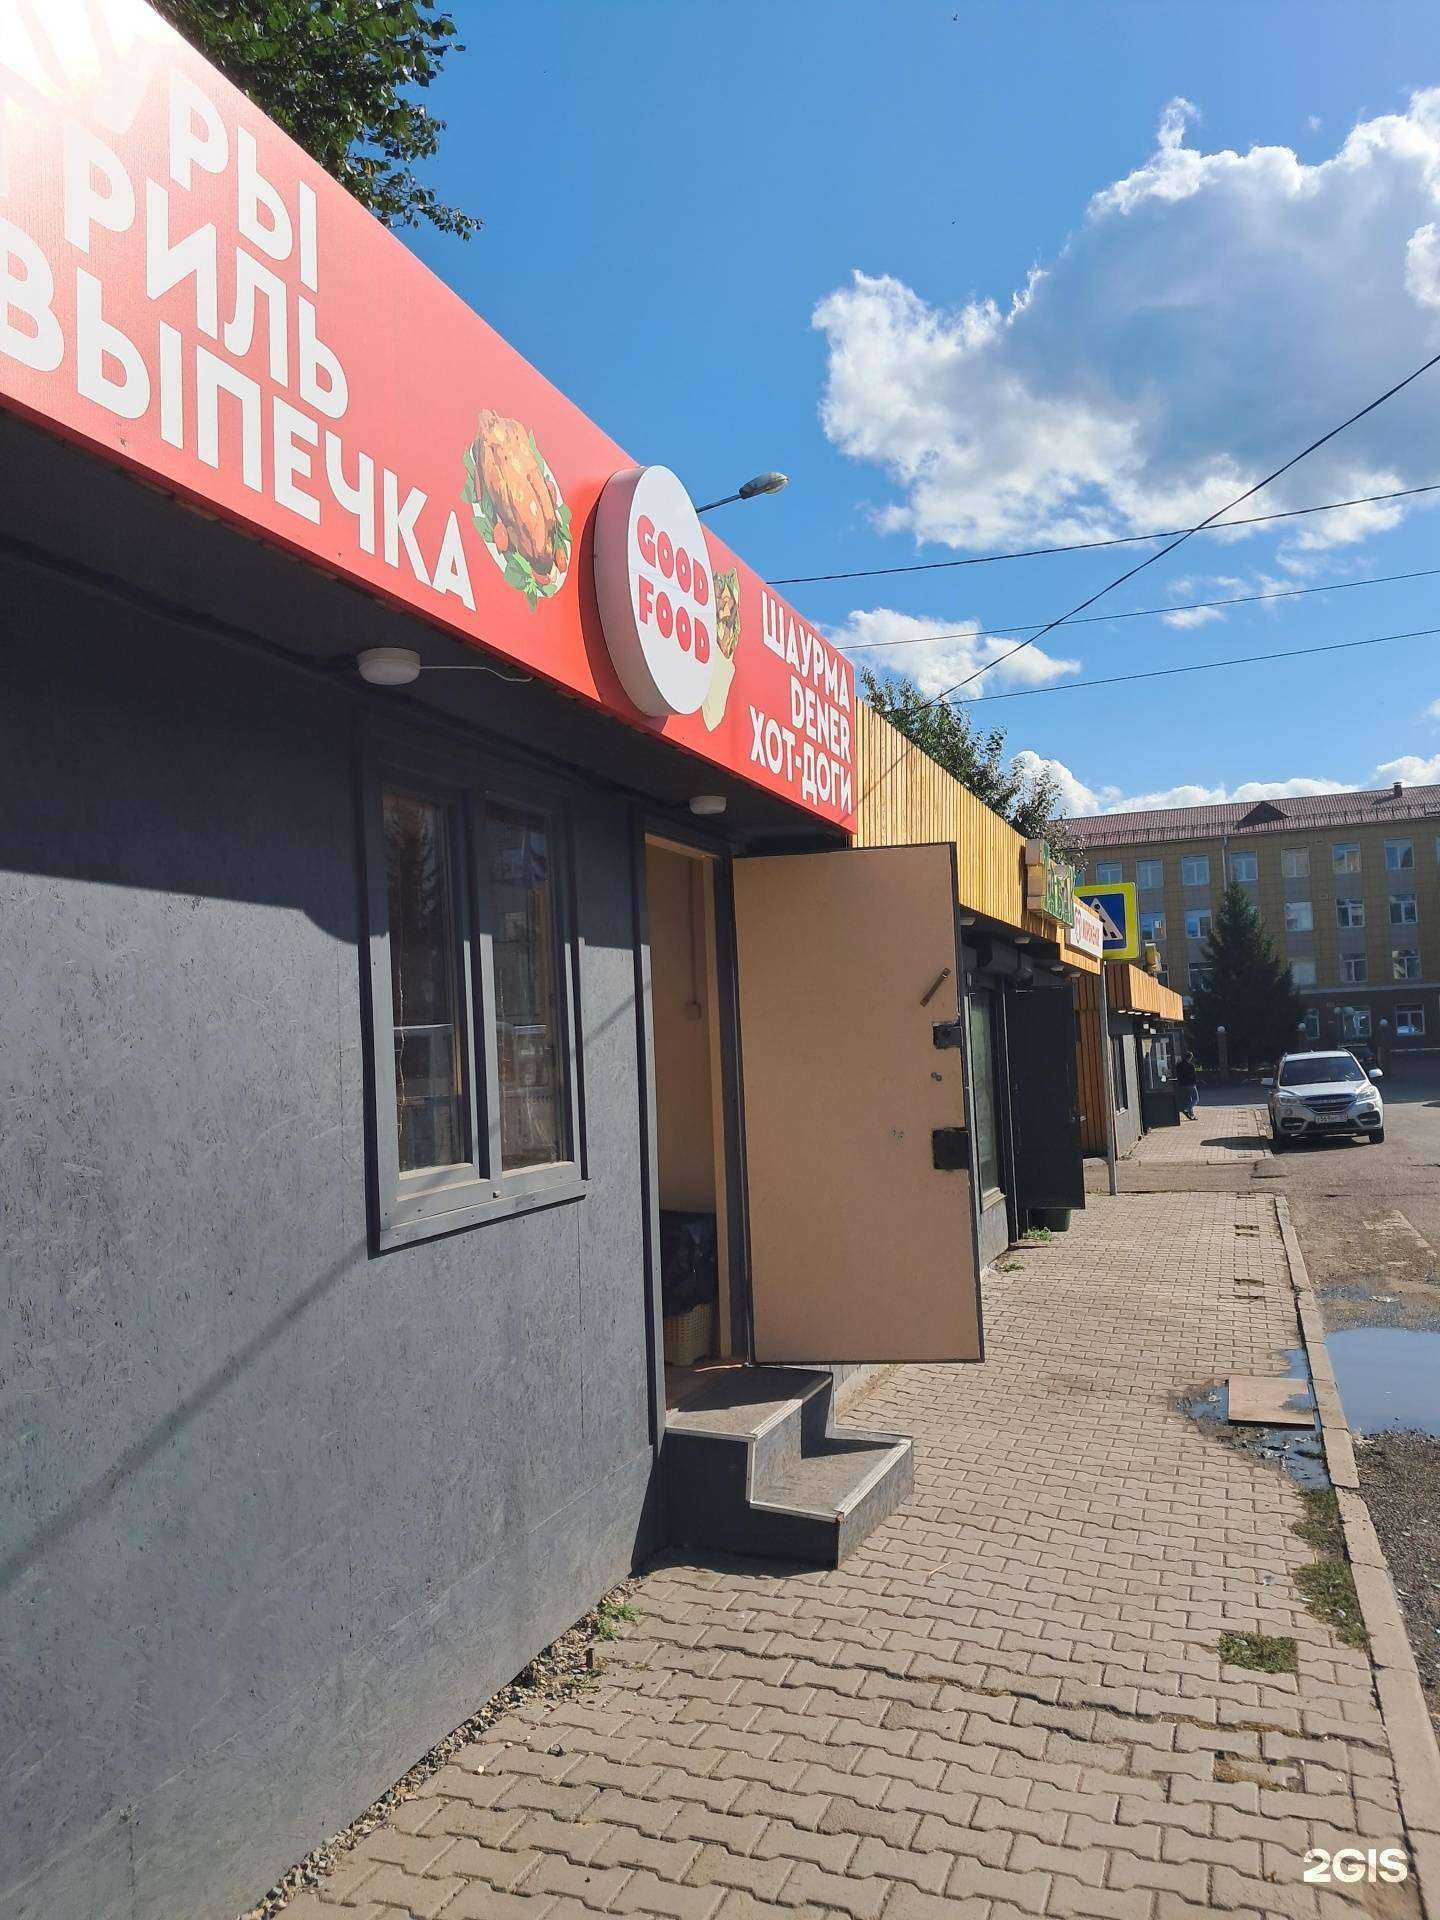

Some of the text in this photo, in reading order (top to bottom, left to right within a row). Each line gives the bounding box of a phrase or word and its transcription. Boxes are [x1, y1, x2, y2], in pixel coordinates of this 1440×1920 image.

[0, 0, 318, 293] УРЫ
[0, 98, 349, 420] РИЛЬ
[0, 217, 477, 612] ВЫПЕЧКА
[636, 514, 709, 606] GOOD
[638, 574, 711, 665] FOOD
[761, 590, 850, 713] ШАУРМА
[750, 704, 852, 815] ХОТ-ДОГИ
[790, 675, 851, 764] DENER
